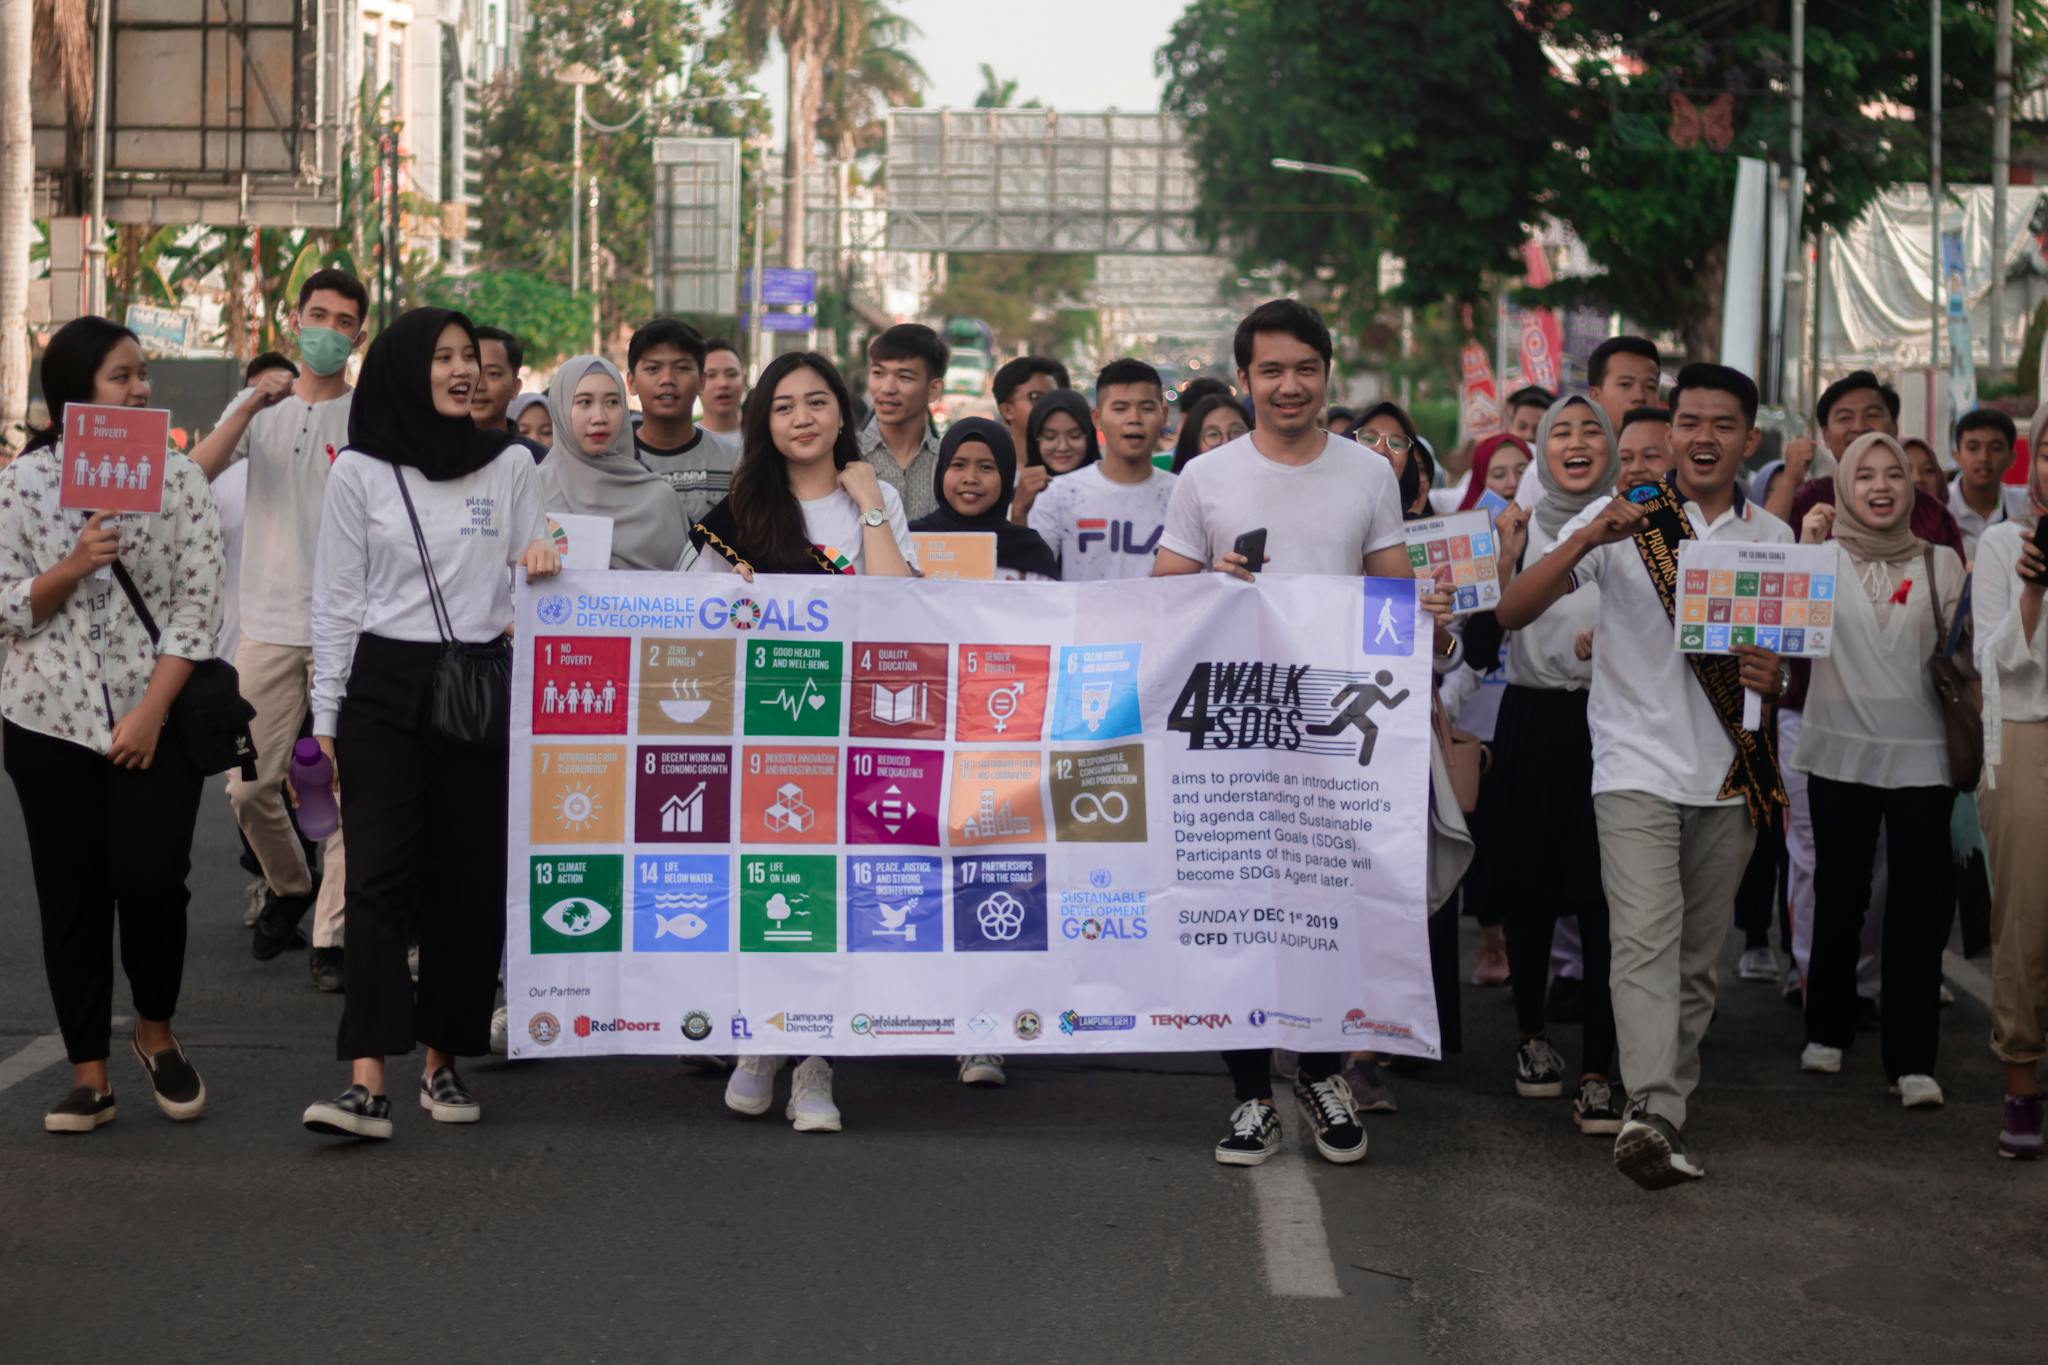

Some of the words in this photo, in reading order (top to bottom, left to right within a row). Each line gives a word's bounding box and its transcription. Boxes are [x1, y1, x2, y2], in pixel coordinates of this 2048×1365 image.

[77, 414, 85, 436] 1
[95, 414, 106, 426] NO
[93, 427, 128, 439] POVERTY
[1645, 527, 1677, 586] PROVINSI
[577, 595, 695, 612] SUSTAINABLE
[576, 613, 694, 629] DEVELOPMENT
[699, 597, 829, 632] GOALS
[545, 643, 552, 666] 1
[561, 644, 571, 654] NO
[649, 646, 660, 666] 2
[773, 648, 794, 657] GOOD
[794, 648, 820, 658] HEALTH
[879, 650, 908, 660] QUALITY
[560, 655, 593, 666] POVERTY
[755, 647, 766, 668] 3
[772, 659, 788, 668] AND
[788, 660, 829, 670] WELL-BEING
[860, 650, 872, 671] 4
[968, 652, 977, 673] 5
[1068, 653, 1078, 674] 6
[878, 661, 918, 672] EDUCATION
[1212, 661, 1311, 706] WALK
[1167, 662, 1216, 750] 4
[1213, 707, 1303, 750] SDGS
[541, 752, 550, 774] 7
[645, 752, 656, 775] 8
[661, 752, 688, 763] DECENT
[689, 752, 710, 763] WORK
[711, 752, 726, 763] AND
[750, 752, 761, 774] 9
[853, 754, 872, 776] 10
[878, 755, 912, 766] REDUCED
[1078, 752, 1125, 768] RESPONSIBLE
[661, 764, 697, 774] ECONOMIC
[698, 764, 728, 774] GROWTH
[877, 767, 924, 779] INEQUALITIES
[1056, 758, 1073, 780] 12
[1080, 762, 1128, 778] CONSUMPTION
[1096, 774, 1138, 785] PRODUCTION
[1172, 772, 1206, 785] aims
[1211, 773, 1224, 784] to
[1230, 770, 1280, 788] provide
[1284, 774, 1298, 786] an
[1302, 774, 1379, 792] introduction
[1173, 791, 1198, 804] and
[1204, 790, 1299, 808] understanding
[1304, 795, 1315, 806] of
[1317, 795, 1335, 810] the
[1340, 798, 1391, 812] world's
[1174, 810, 1194, 826] big
[1200, 810, 1254, 826] agenda
[1260, 809, 1295, 823] called
[1299, 813, 1372, 832] Sustainable
[1175, 829, 1271, 847] Development
[1275, 828, 1308, 845] Goals
[1312, 833, 1360, 851] (SDGs).
[558, 862, 587, 872] CLIMATE
[664, 862, 679, 872] LIFE
[770, 862, 784, 872] LIFE
[902, 862, 931, 872] JUSTICE
[982, 861, 1034, 871] PARTNERSHIPS
[1176, 848, 1261, 866] Participants
[1267, 848, 1278, 859] of
[1282, 849, 1301, 863] this
[1305, 852, 1346, 868] parade
[1352, 857, 1371, 870] will
[536, 862, 552, 884] 13
[557, 873, 584, 884] ACTION
[640, 862, 658, 884] 14
[664, 873, 690, 883] BELOW
[690, 874, 713, 884] WATER
[747, 862, 766, 884] 15
[770, 874, 780, 883] ON
[782, 874, 801, 884] LAND
[853, 862, 872, 884] 16
[876, 874, 890, 884] AND
[892, 874, 920, 884] STRONG
[961, 862, 978, 884] 17
[982, 872, 996, 883] FOR
[996, 872, 1009, 883] THE
[1010, 872, 1033, 883] GOALS
[1177, 868, 1234, 881] become
[1240, 866, 1280, 880] SDGs
[1284, 868, 1317, 885] Agent
[1320, 873, 1353, 888] later.
[876, 885, 924, 896] INSTITUTIONS
[1060, 890, 1148, 905] SUSTAINABLE
[1060, 905, 1146, 917] DEVELOPMENT
[1179, 909, 1249, 924] SUNDAY
[1254, 908, 1284, 922] DEC
[1306, 914, 1338, 930] 2019
[1062, 918, 1148, 940] GOALS
[1234, 931, 1277, 945] TUGU
[1281, 933, 1338, 952] ADIPURA
[529, 987, 547, 998] Our
[550, 986, 591, 997] Partners
[591, 1018, 661, 1032] RedDoorz
[786, 1012, 834, 1024] Lampung
[1080, 1016, 1113, 1026] LAMPUNG
[1150, 1014, 1232, 1030] TEKNOKRA
[786, 1023, 834, 1035] Directory
